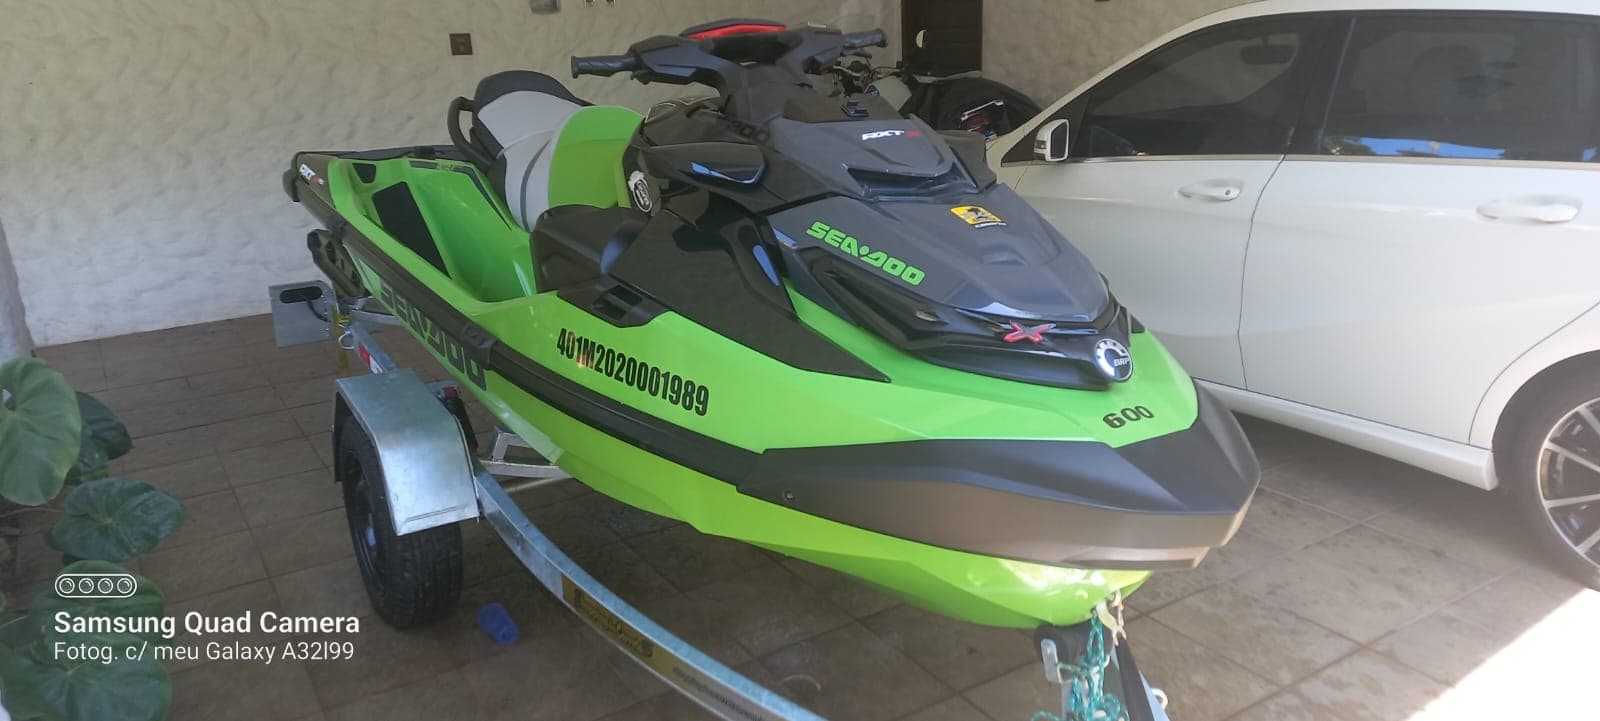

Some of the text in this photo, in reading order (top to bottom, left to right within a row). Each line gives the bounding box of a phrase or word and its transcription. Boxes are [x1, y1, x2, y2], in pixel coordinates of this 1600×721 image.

[557, 328, 709, 416] 401M2020001989
[1113, 358, 1130, 367] BRP
[1102, 405, 1154, 429] 600
